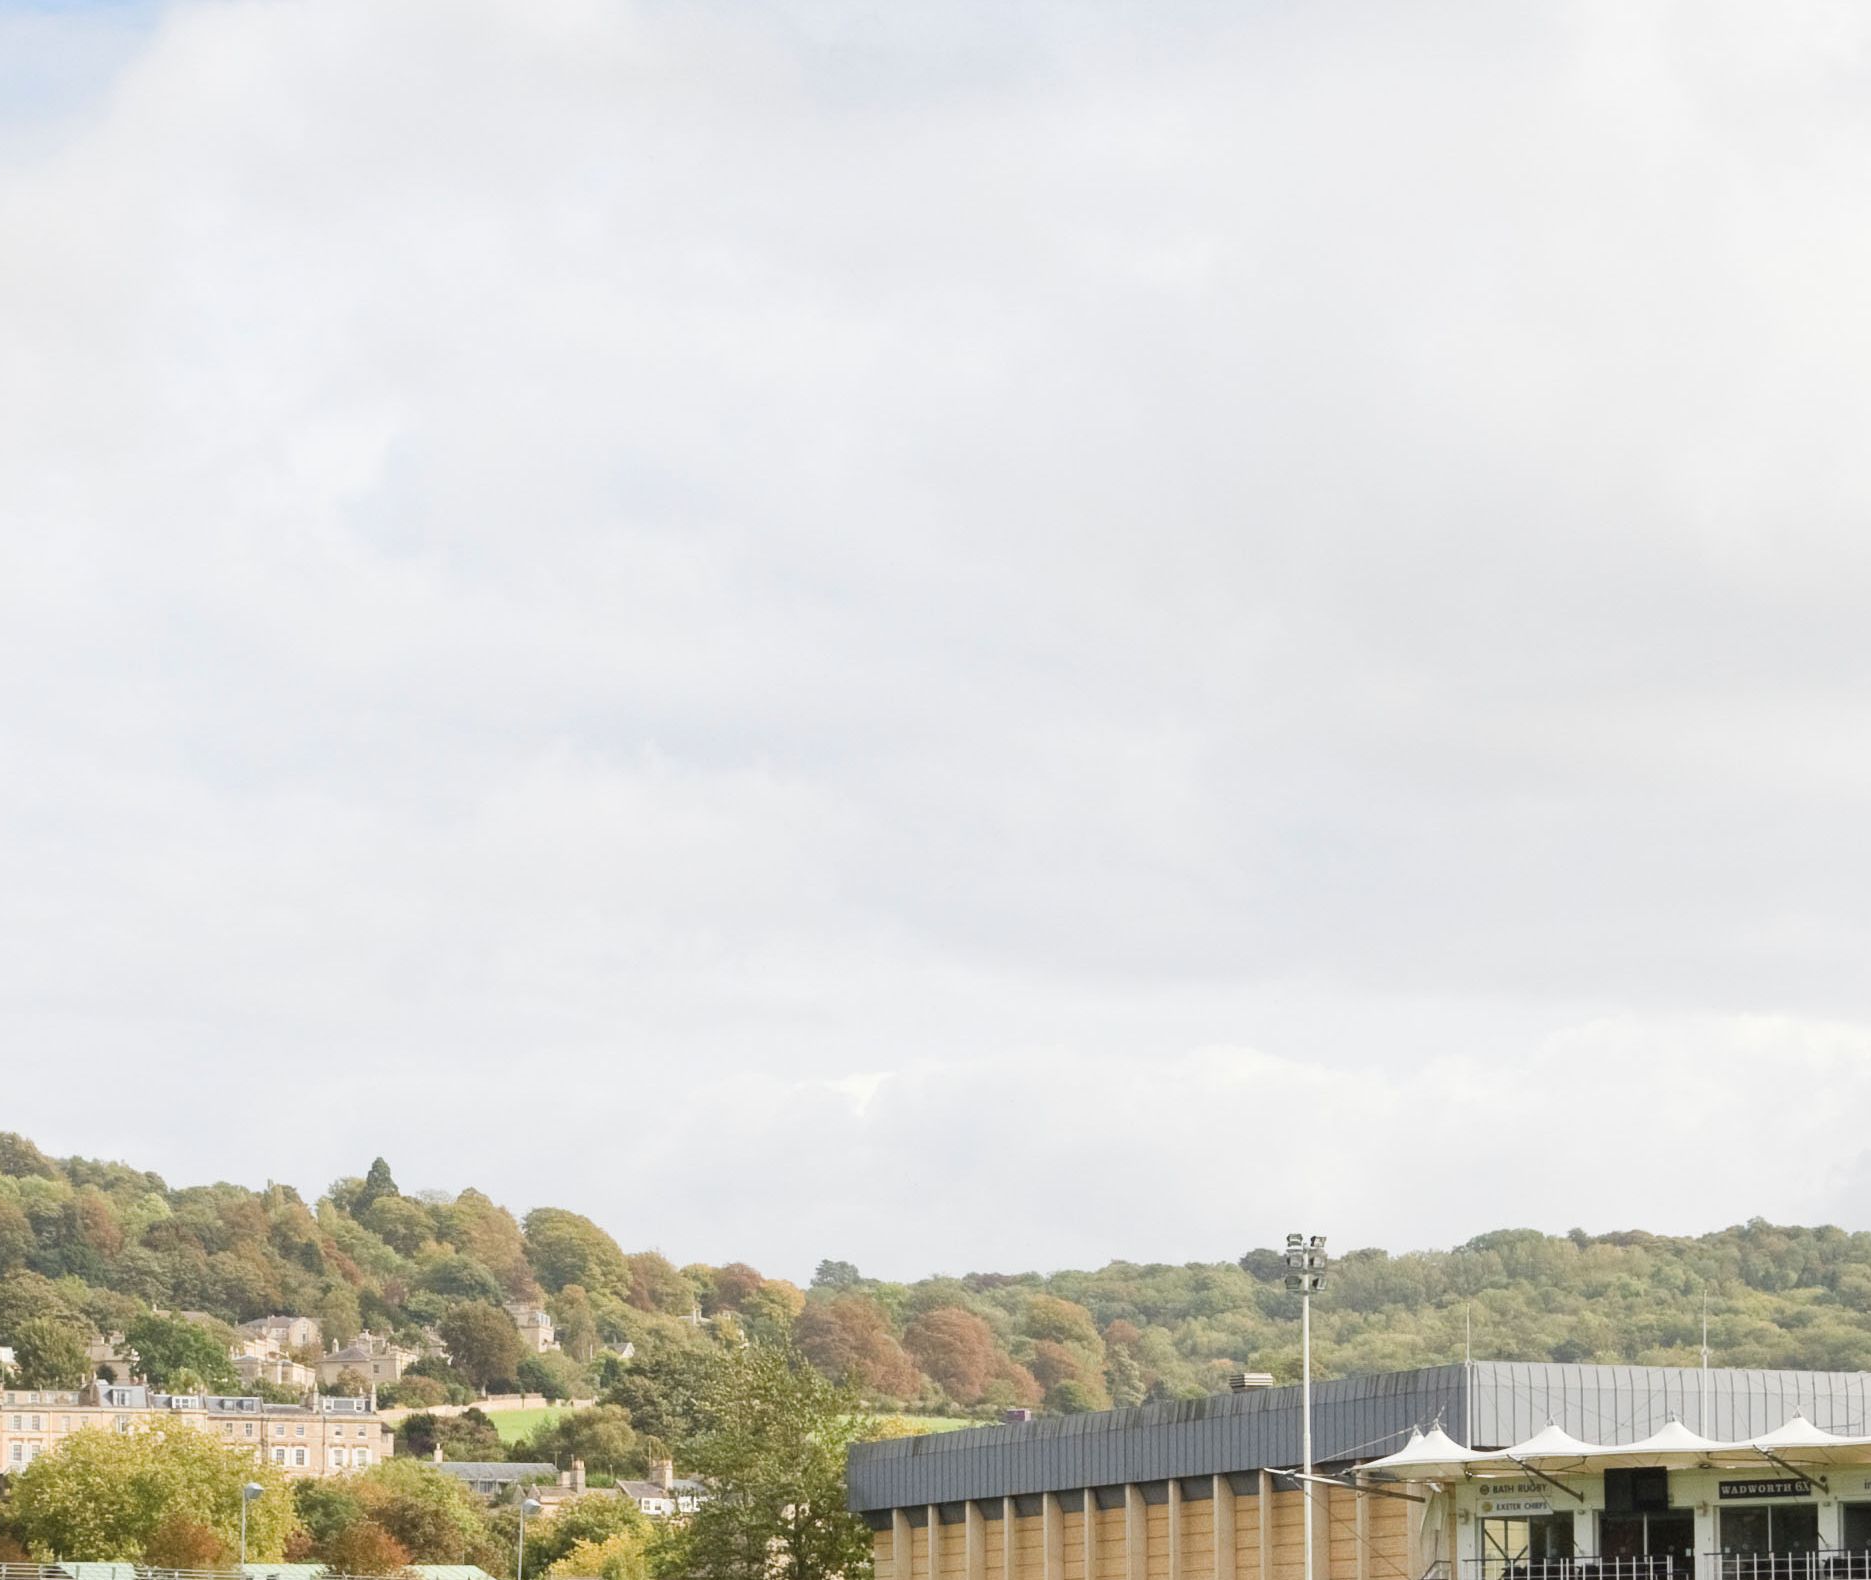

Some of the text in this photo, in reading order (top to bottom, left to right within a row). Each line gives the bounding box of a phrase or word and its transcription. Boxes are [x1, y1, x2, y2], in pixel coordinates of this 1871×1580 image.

[1493, 1483, 1548, 1494] BATH RUGBY
[1721, 1483, 1791, 1495] WADWORTH
